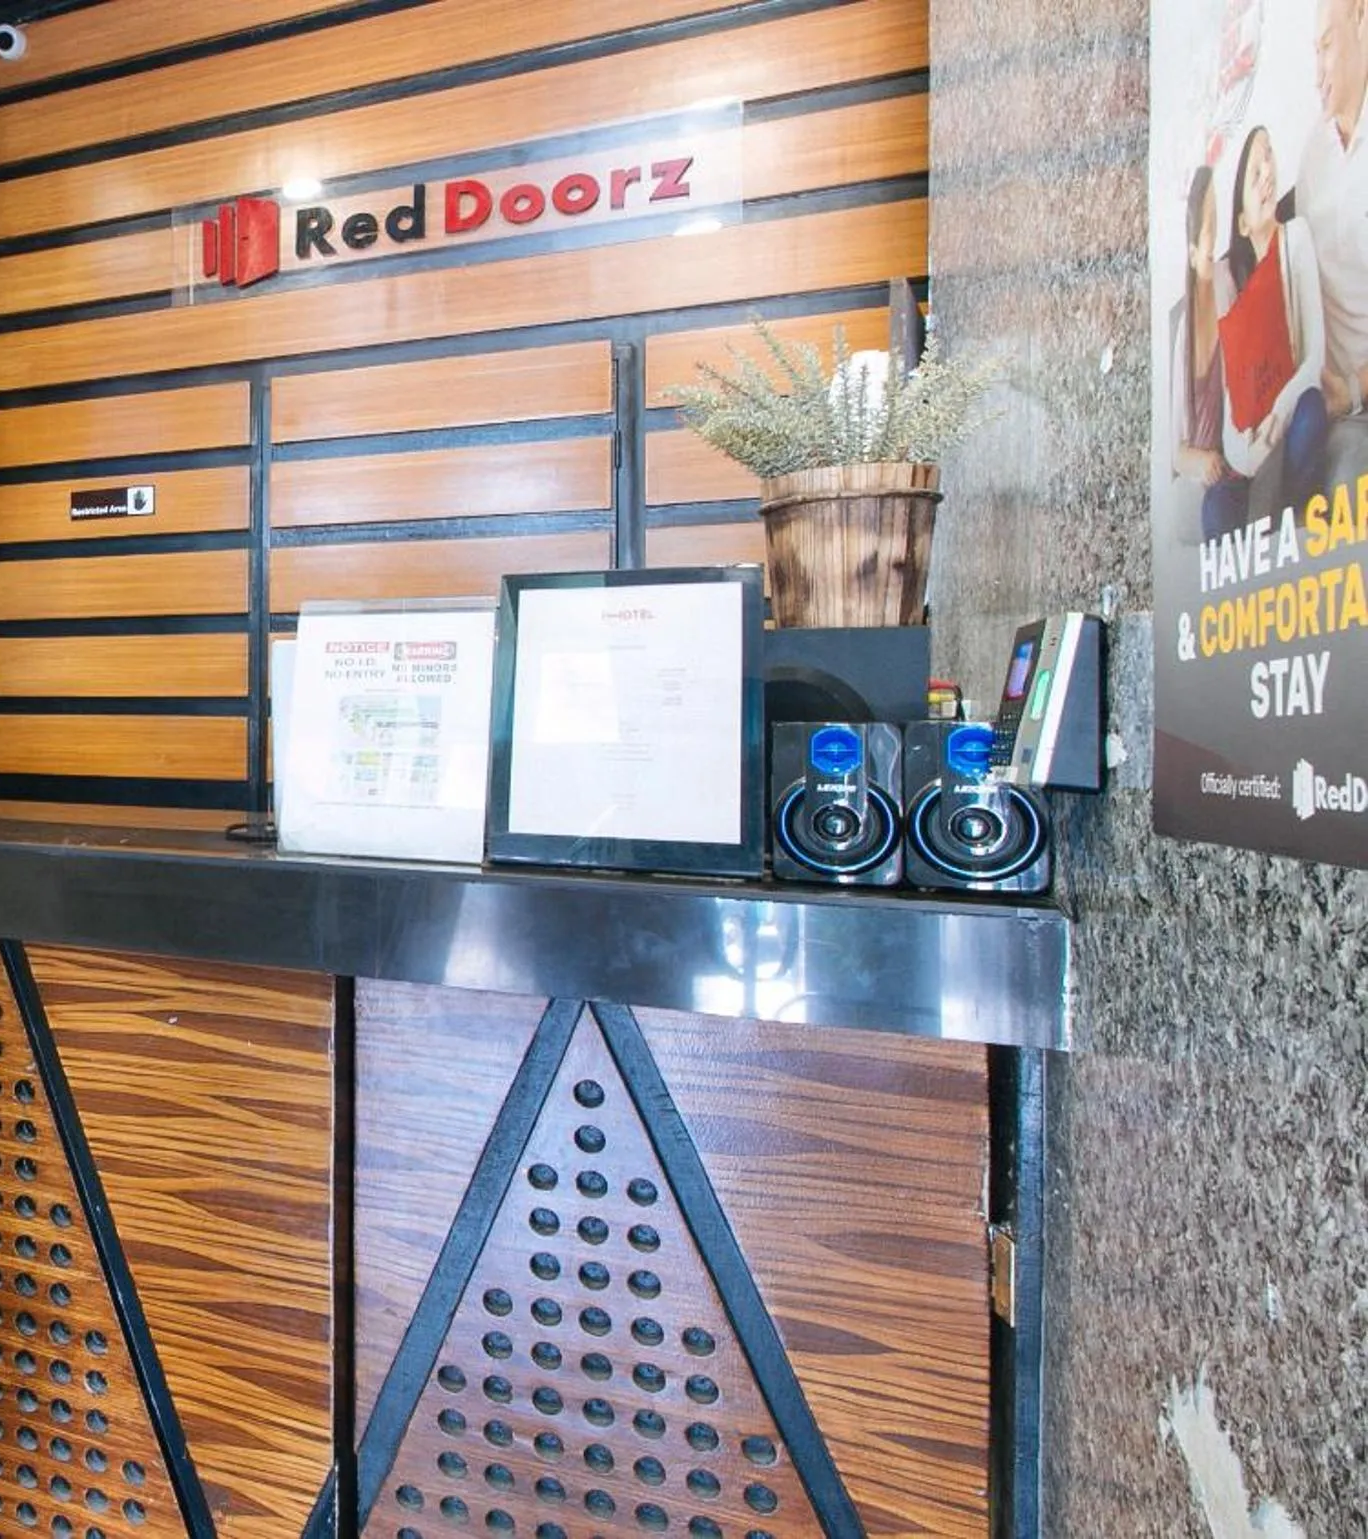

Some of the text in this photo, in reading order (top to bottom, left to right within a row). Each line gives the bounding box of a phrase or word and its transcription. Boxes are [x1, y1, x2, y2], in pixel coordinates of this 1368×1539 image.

[1200, 515, 1271, 592] HAVE
[1276, 506, 1300, 568] A
[1177, 612, 1196, 661] &
[1250, 651, 1330, 719] STAY
[1200, 772, 1237, 800] Officially
